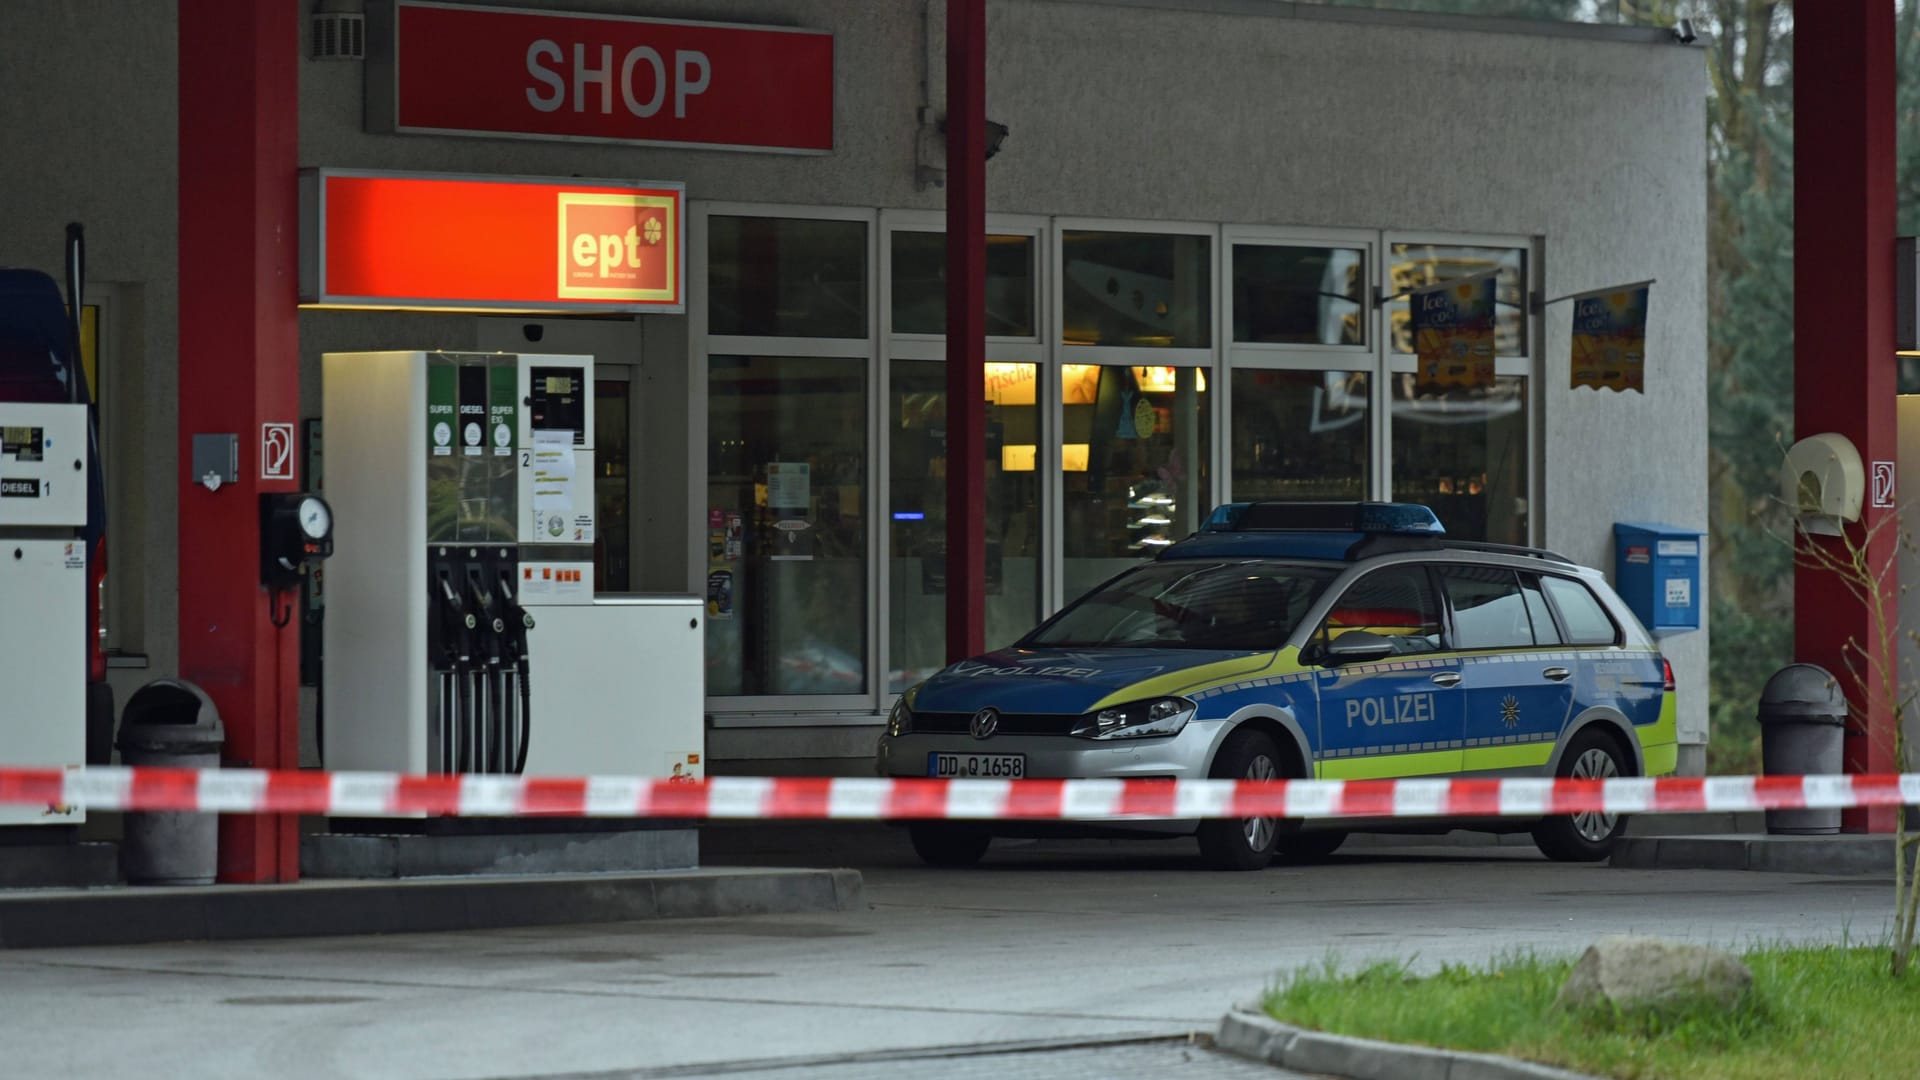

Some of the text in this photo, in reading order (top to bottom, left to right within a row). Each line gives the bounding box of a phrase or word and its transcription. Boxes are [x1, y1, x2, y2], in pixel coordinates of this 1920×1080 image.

[525, 38, 711, 119] SHOP
[572, 224, 641, 279] ept
[429, 404, 453, 414] SUPER
[460, 405, 485, 414] DIESEL
[491, 406, 514, 415] SUPER
[491, 416, 504, 424] E10
[522, 453, 530, 467] 2
[2, 481, 50, 497] DIESEL 1
[970, 665, 1104, 679] POLIZEI
[1345, 692, 1435, 728] POLIZEI
[939, 756, 1022, 777] DD Q 1658
